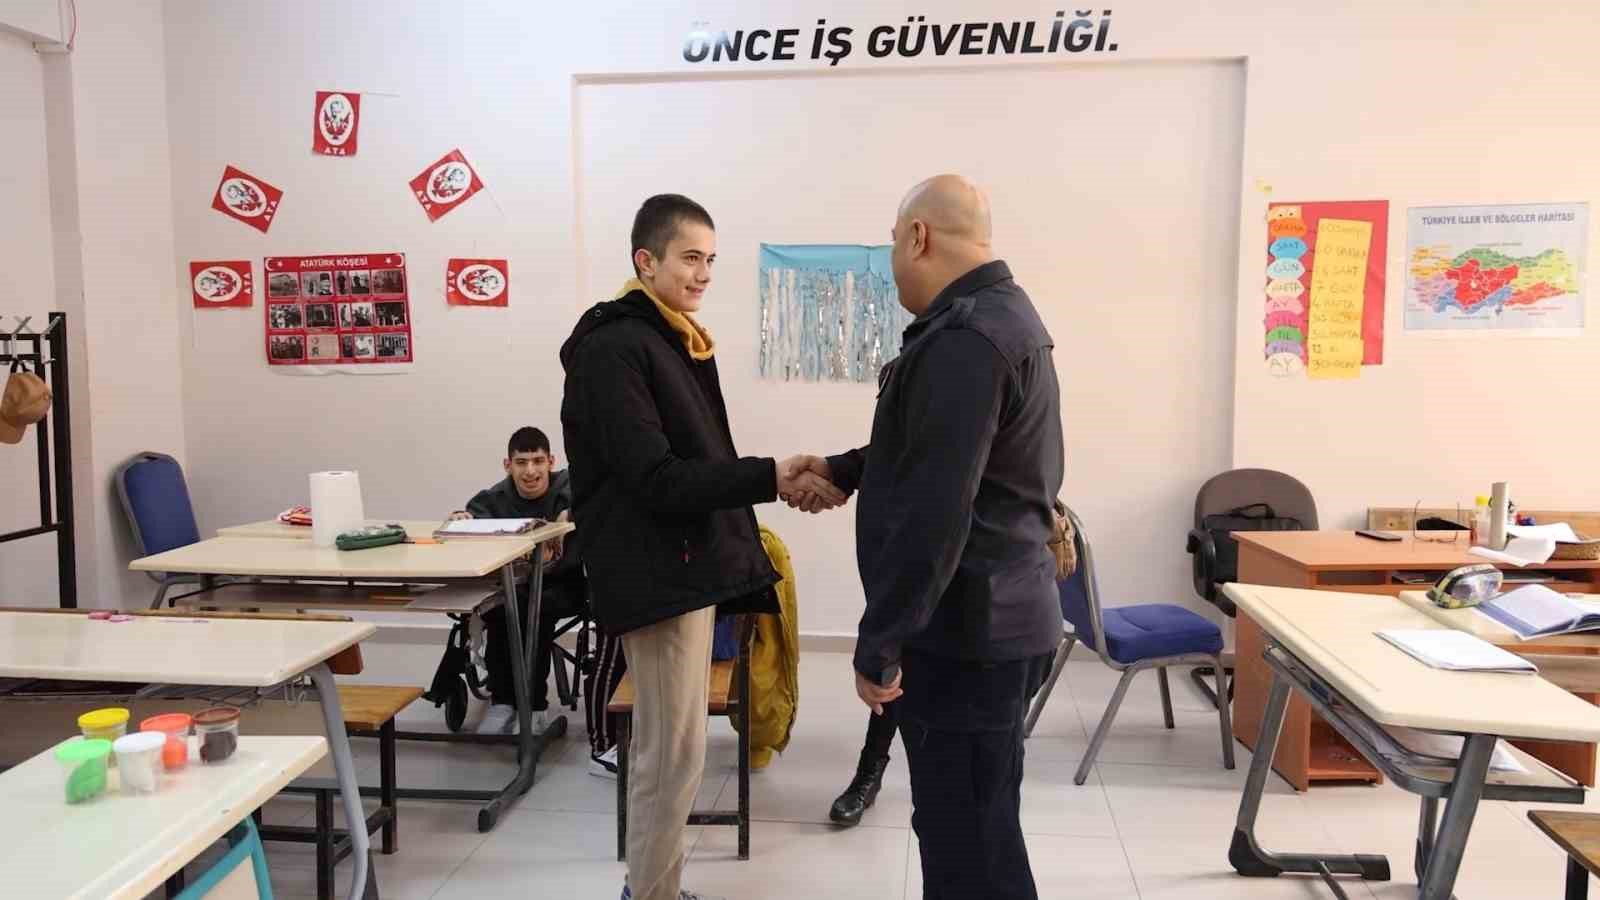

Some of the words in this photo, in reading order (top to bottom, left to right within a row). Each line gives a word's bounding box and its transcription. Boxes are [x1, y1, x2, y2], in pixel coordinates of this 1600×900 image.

[810, 18, 854, 66] İŞ
[866, 9, 1119, 58] GÜVENLİĞİ.
[324, 146, 347, 156] ATA
[1423, 215, 1457, 225] TÜRKİYE
[1482, 214, 1494, 224] VE
[1495, 213, 1536, 224] BÖLGELER
[299, 258, 335, 268] ATATÜRK
[336, 255, 369, 268] KÖŞESİ
